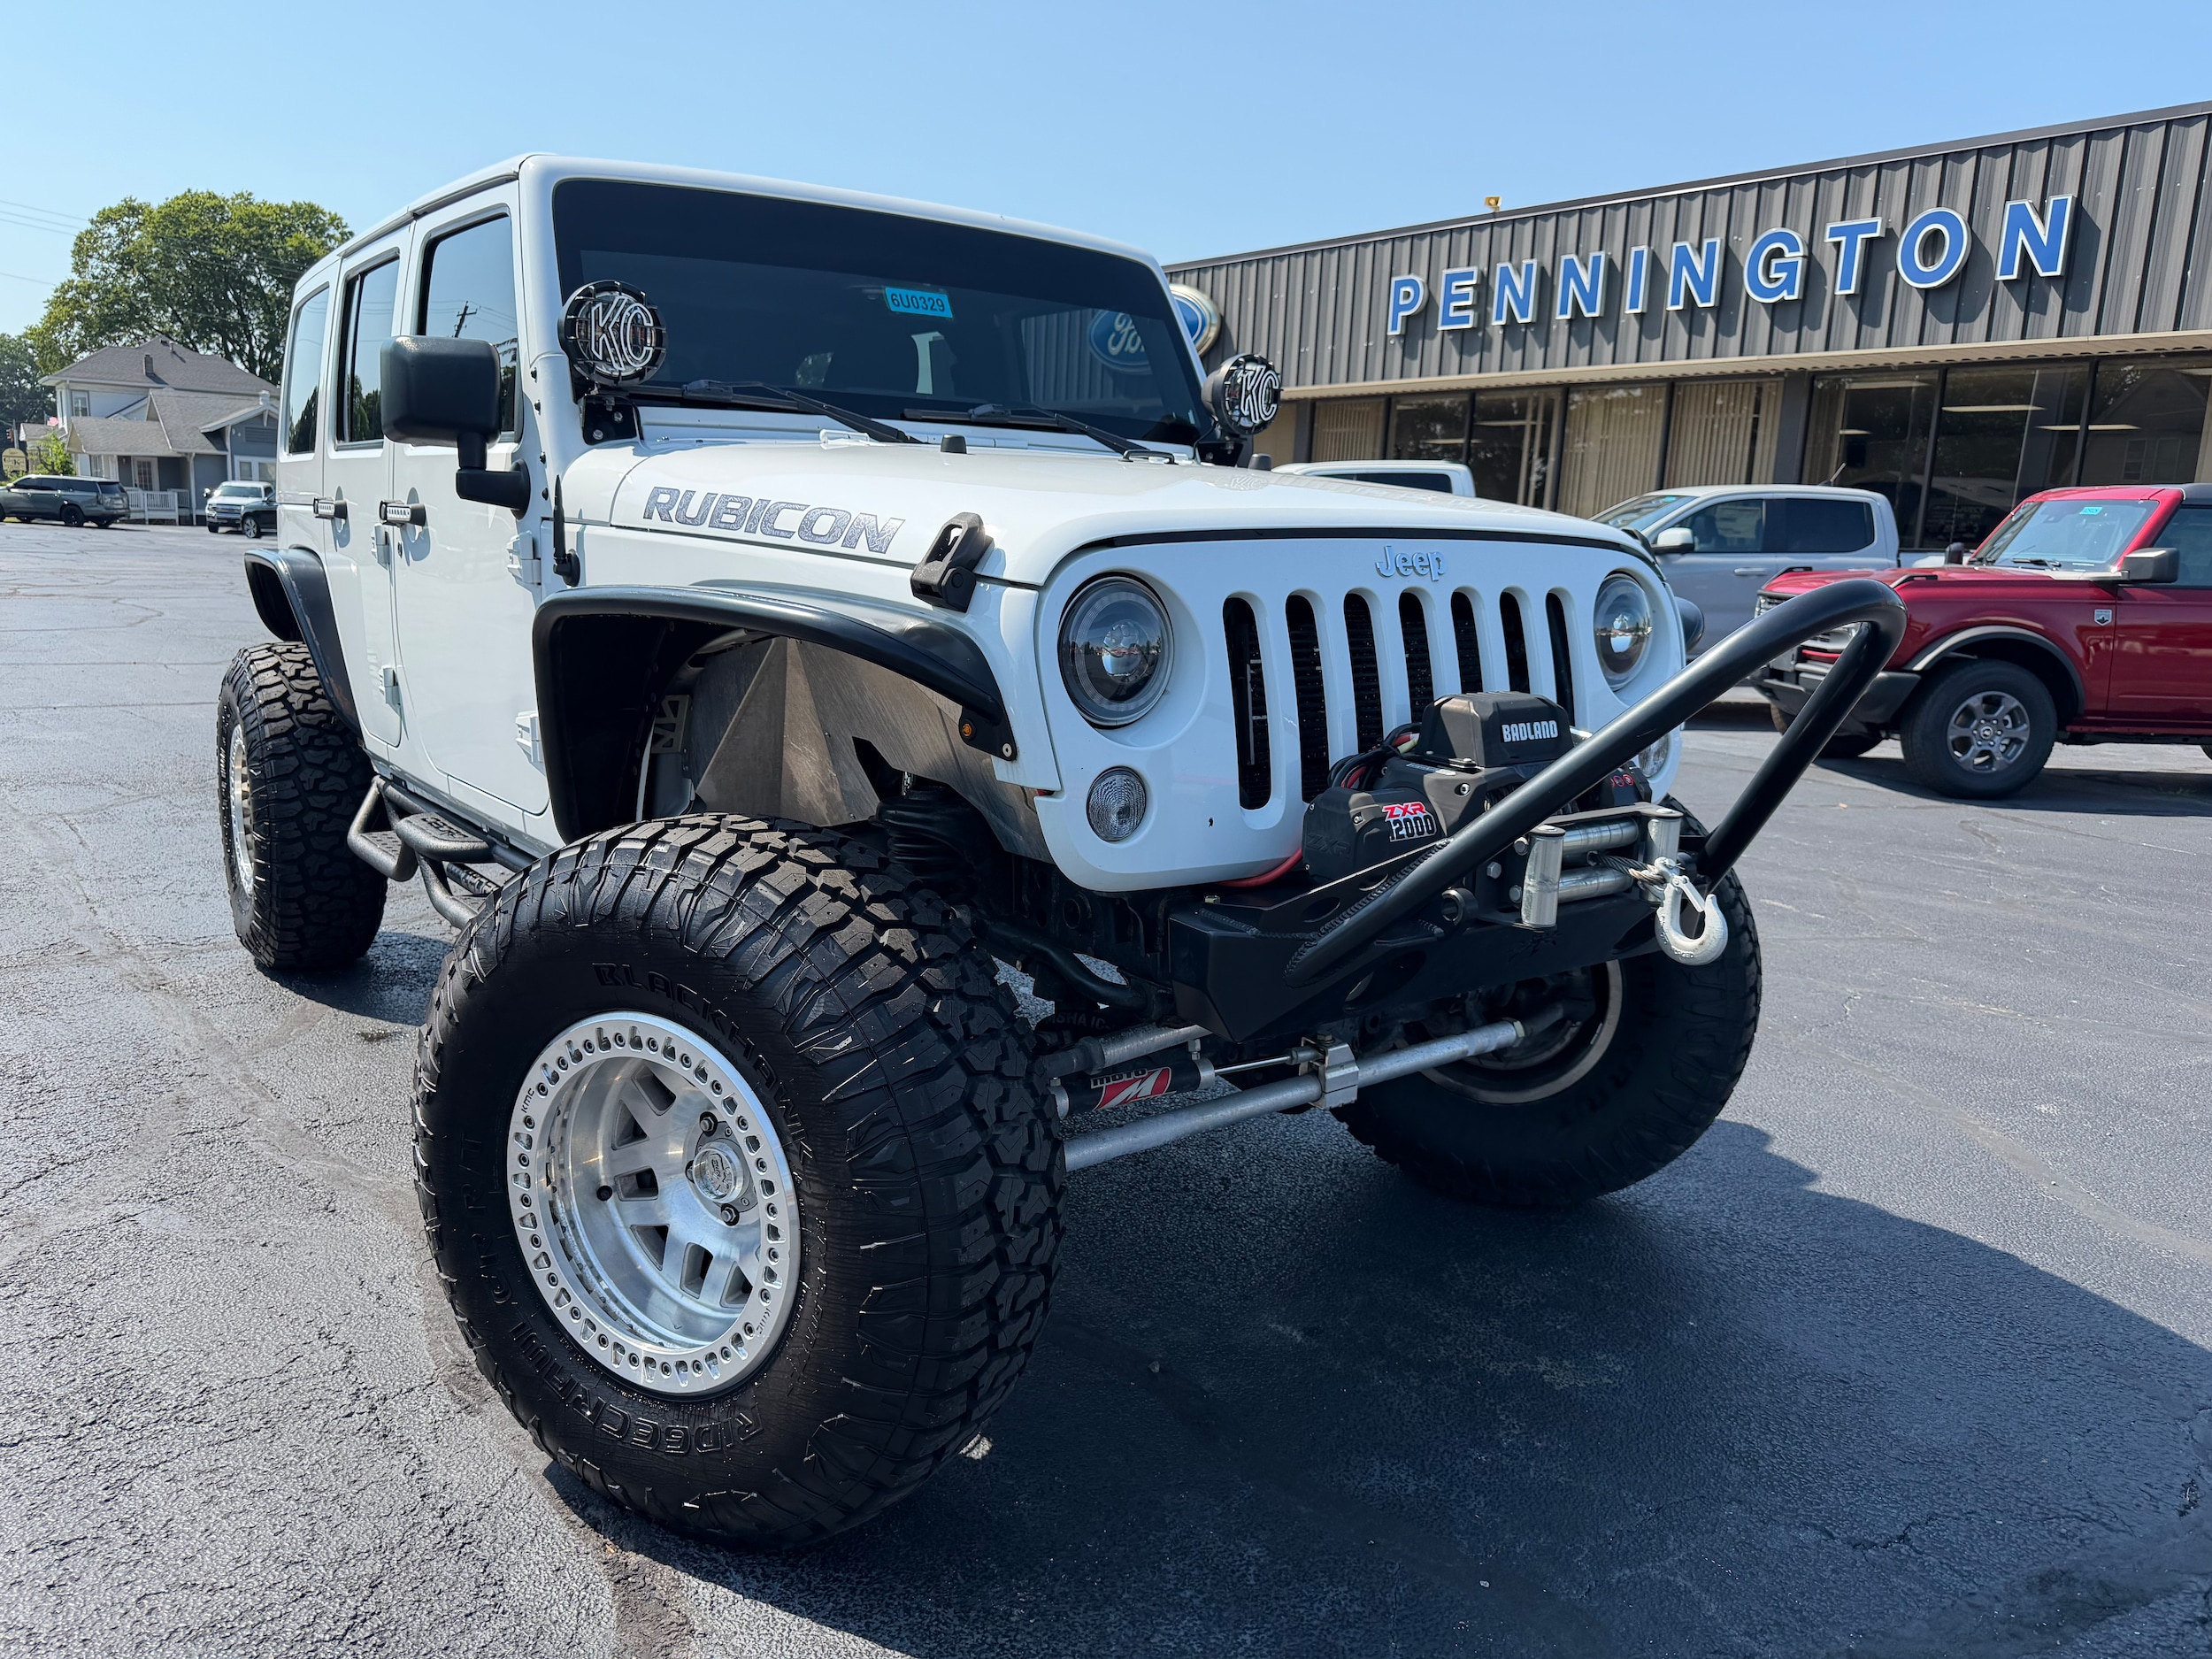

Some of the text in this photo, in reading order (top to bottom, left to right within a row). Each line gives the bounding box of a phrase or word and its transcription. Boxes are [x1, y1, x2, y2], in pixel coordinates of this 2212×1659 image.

[1387, 193, 2077, 336] PENNINGTON
[890, 293, 945, 312] 6U0329
[591, 296, 654, 371] KC
[1240, 365, 1279, 424] KC
[643, 486, 906, 554] RUBICON
[1375, 545, 1447, 582] Jeep
[1502, 720, 1559, 742] BADLAND
[1382, 801, 1427, 819] ZXR
[1390, 815, 1436, 840] 12000
